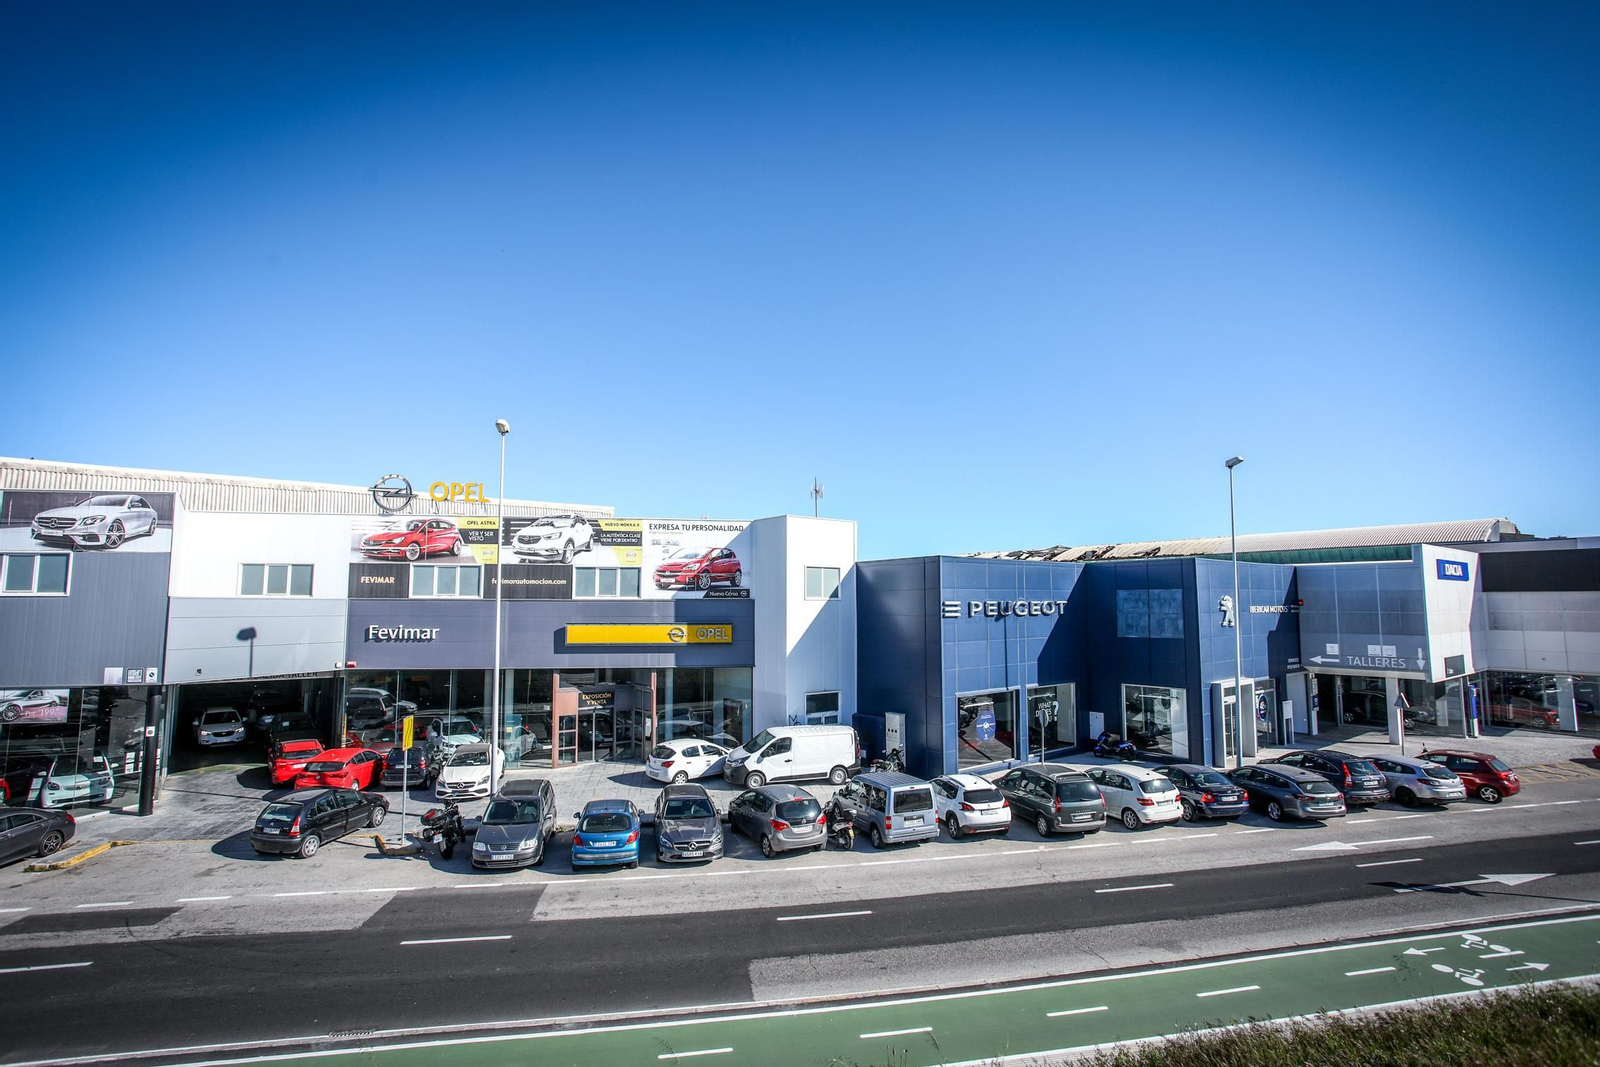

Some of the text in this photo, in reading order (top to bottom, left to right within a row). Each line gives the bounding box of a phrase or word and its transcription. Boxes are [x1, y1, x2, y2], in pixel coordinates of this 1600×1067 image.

[430, 482, 491, 503] OPEL
[649, 523, 680, 531] EXPRESA
[691, 524, 744, 532] PERSONALIDAD
[1444, 563, 1463, 577] DACIA
[361, 576, 395, 584] FEVIMAR
[491, 577, 567, 585] feimarautomocion.com
[969, 600, 1068, 617] PEUGEOT
[1249, 605, 1269, 613] IBERICAR
[1269, 605, 1288, 613] MOTORS
[368, 624, 440, 640] Fevimar
[696, 628, 728, 640] OPEL
[1346, 656, 1406, 668] TALLERES
[582, 692, 611, 700] EXPOSICIÓN
